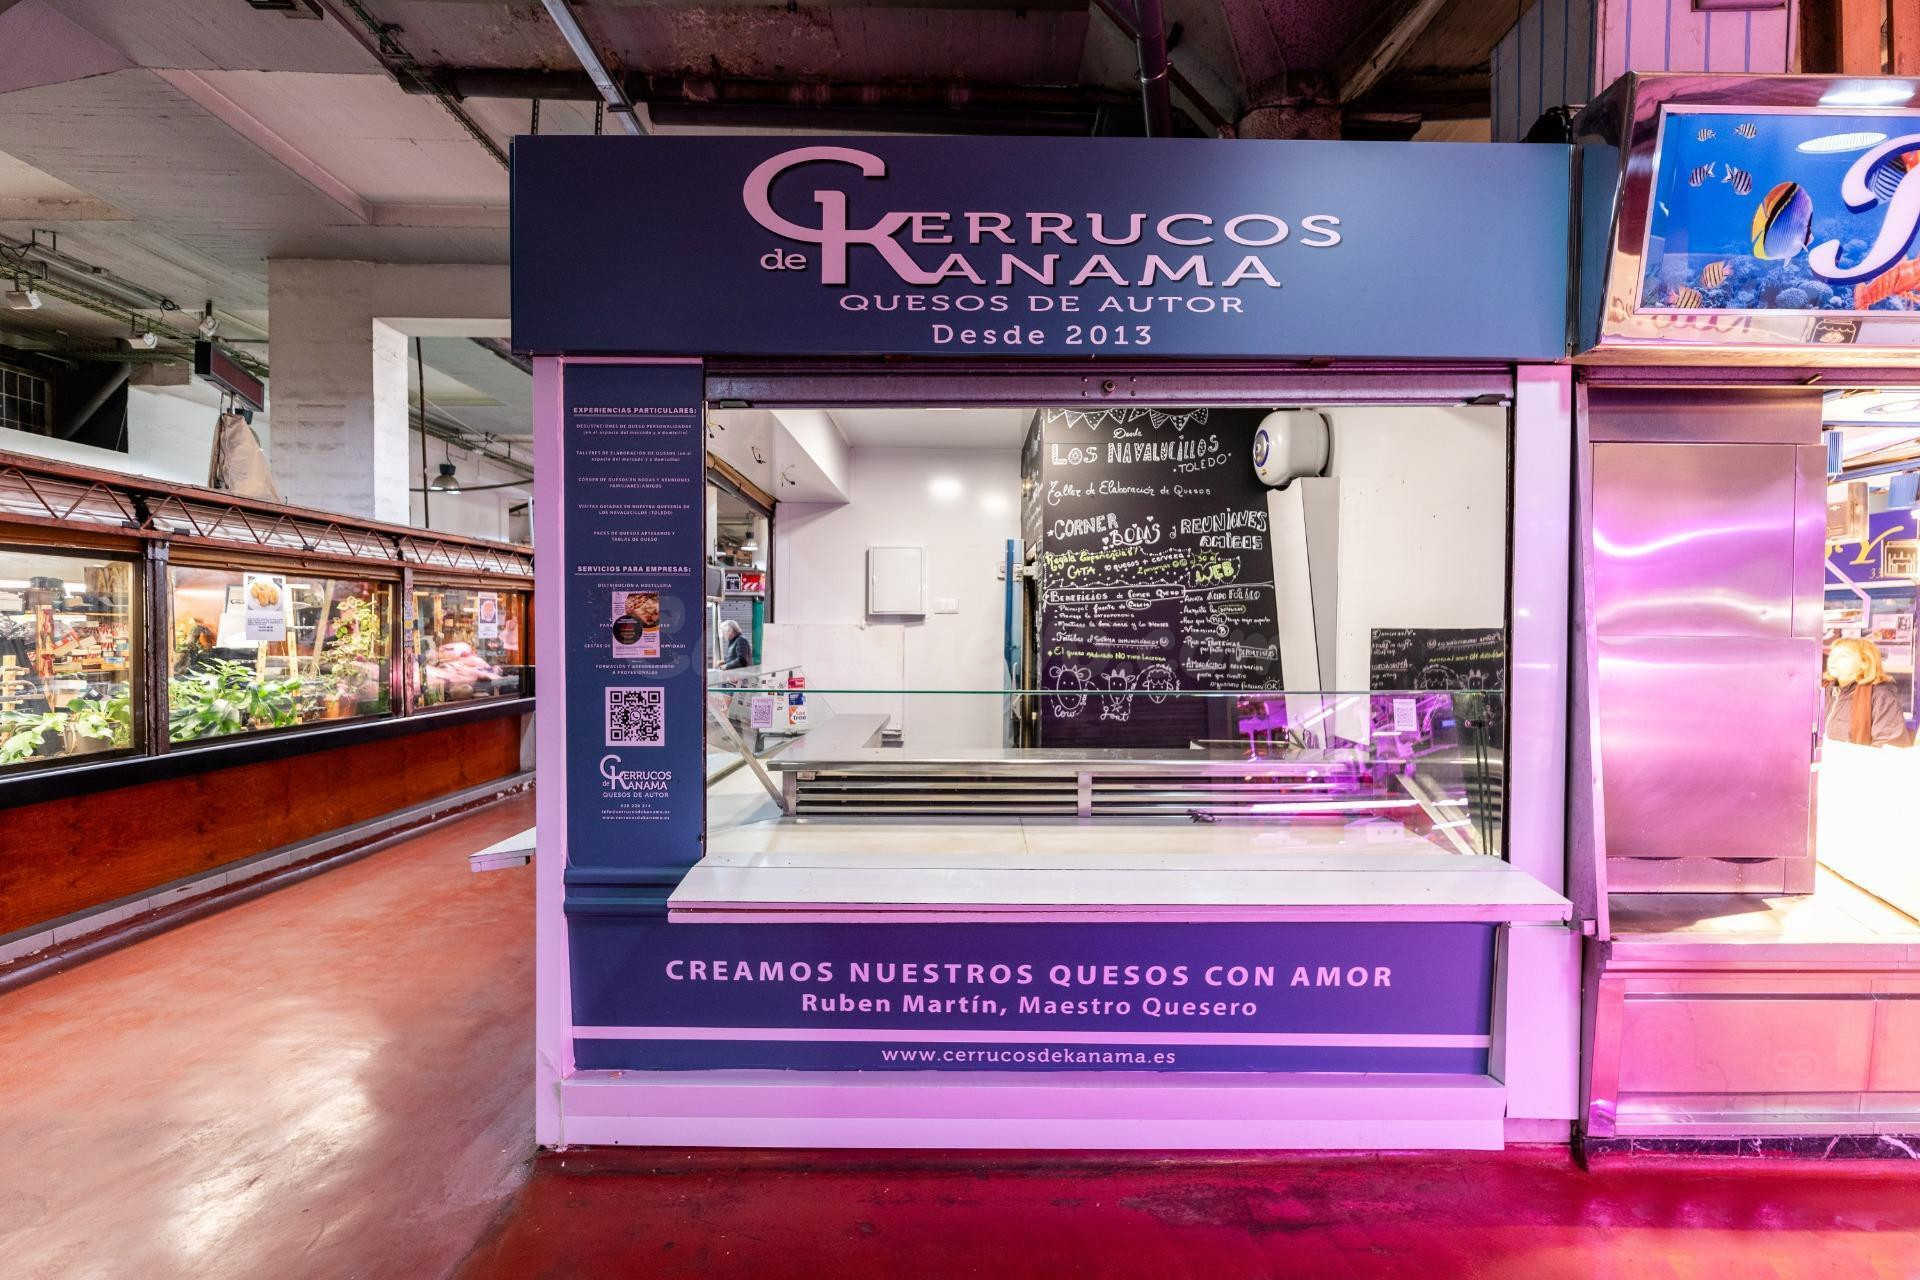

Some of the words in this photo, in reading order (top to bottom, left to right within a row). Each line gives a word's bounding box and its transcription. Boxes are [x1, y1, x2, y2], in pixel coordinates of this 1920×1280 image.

[742, 146, 1342, 249] CERRUCOS
[761, 249, 806, 269] de
[840, 295, 1008, 311] QUESOS
[1028, 296, 1079, 311] DE
[1099, 297, 1243, 312] AUTOR
[933, 325, 1044, 344] Desde
[1066, 326, 1151, 345] 2013
[1054, 513, 1119, 540] CORNER
[1109, 523, 1160, 546] BODAS
[1067, 565, 1096, 579] CATA
[1114, 560, 1139, 572] quesos
[1152, 553, 1184, 563] cerveza
[1054, 647, 1064, 655] El
[666, 961, 832, 981] CREAMOS
[851, 963, 1032, 984] NUESTROS
[1050, 965, 1188, 987] QUESOS
[1205, 966, 1274, 986] CON
[1291, 967, 1391, 986] AMOR
[803, 994, 890, 1011] Ruben
[903, 995, 1006, 1016] Martín,
[1020, 997, 1130, 1014] Maestro
[1143, 998, 1256, 1017] Quesero
[882, 1046, 1176, 1064] www.cerrucosdekanama.es
